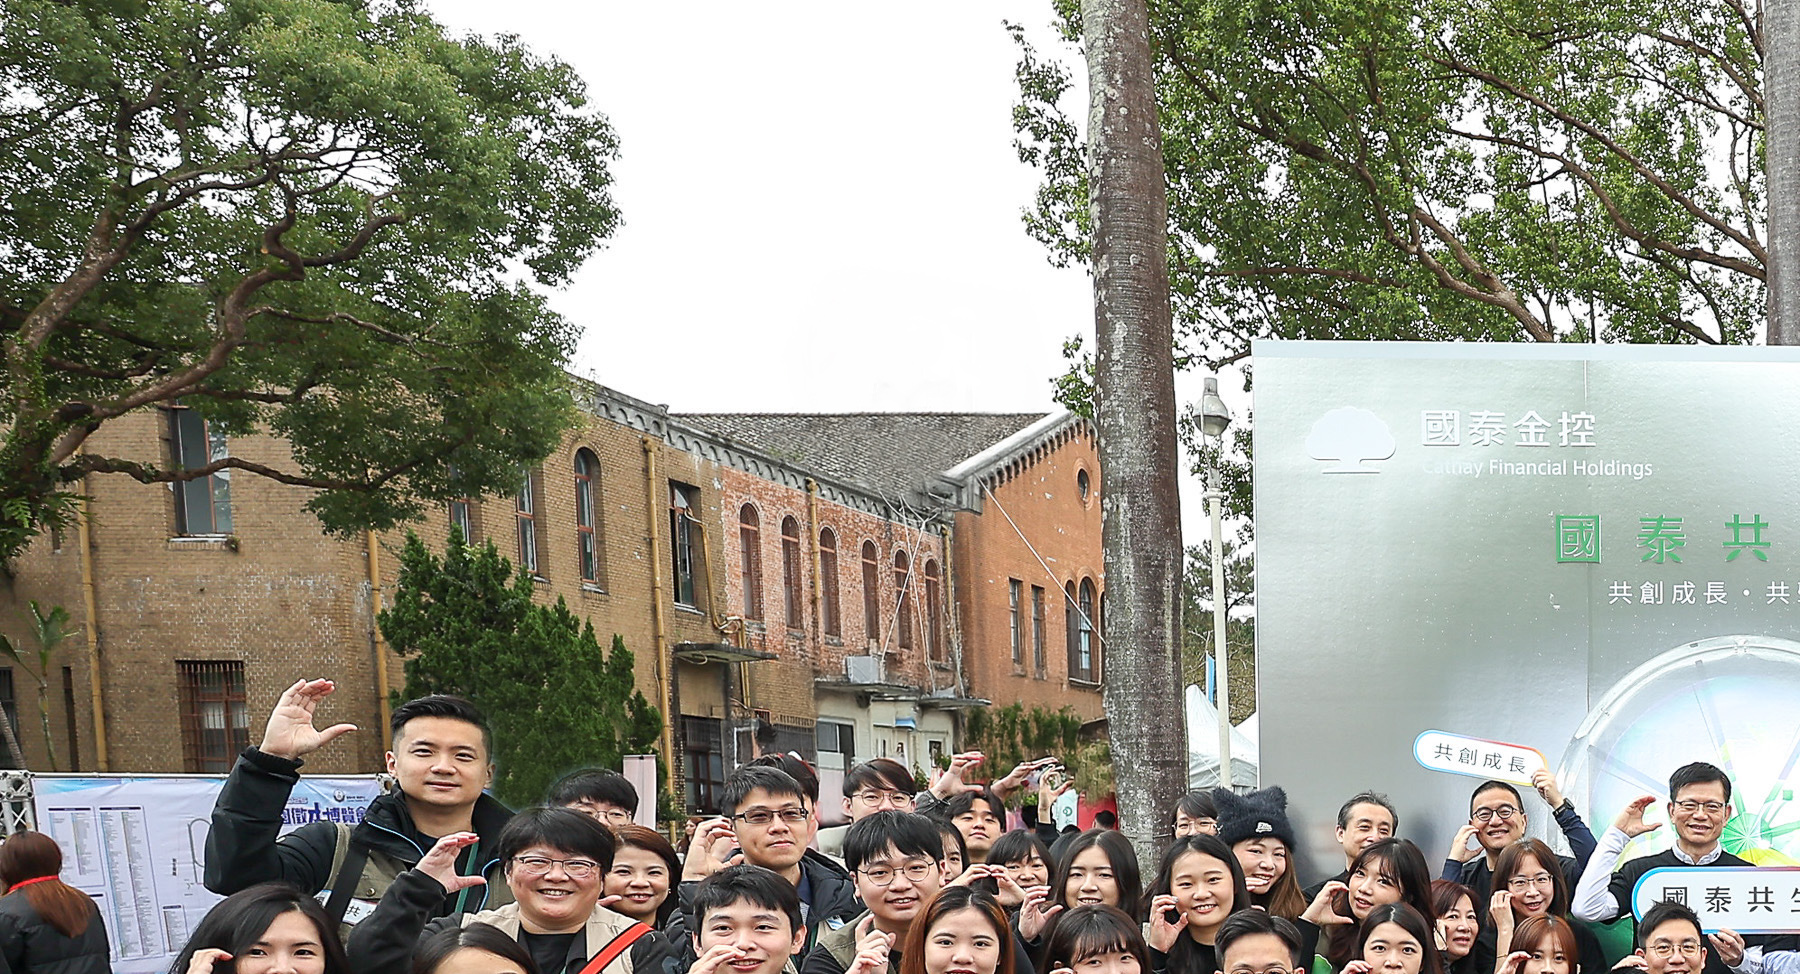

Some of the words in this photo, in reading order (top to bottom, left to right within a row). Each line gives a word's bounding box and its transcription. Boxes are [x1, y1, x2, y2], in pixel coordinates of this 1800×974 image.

[1421, 409, 1597, 448] 國泰金控
[1423, 460, 1483, 478] Cathay
[1489, 459, 1567, 476] Financial
[1573, 459, 1653, 480] Holdings
[1434, 743, 1526, 774] 共創成長
